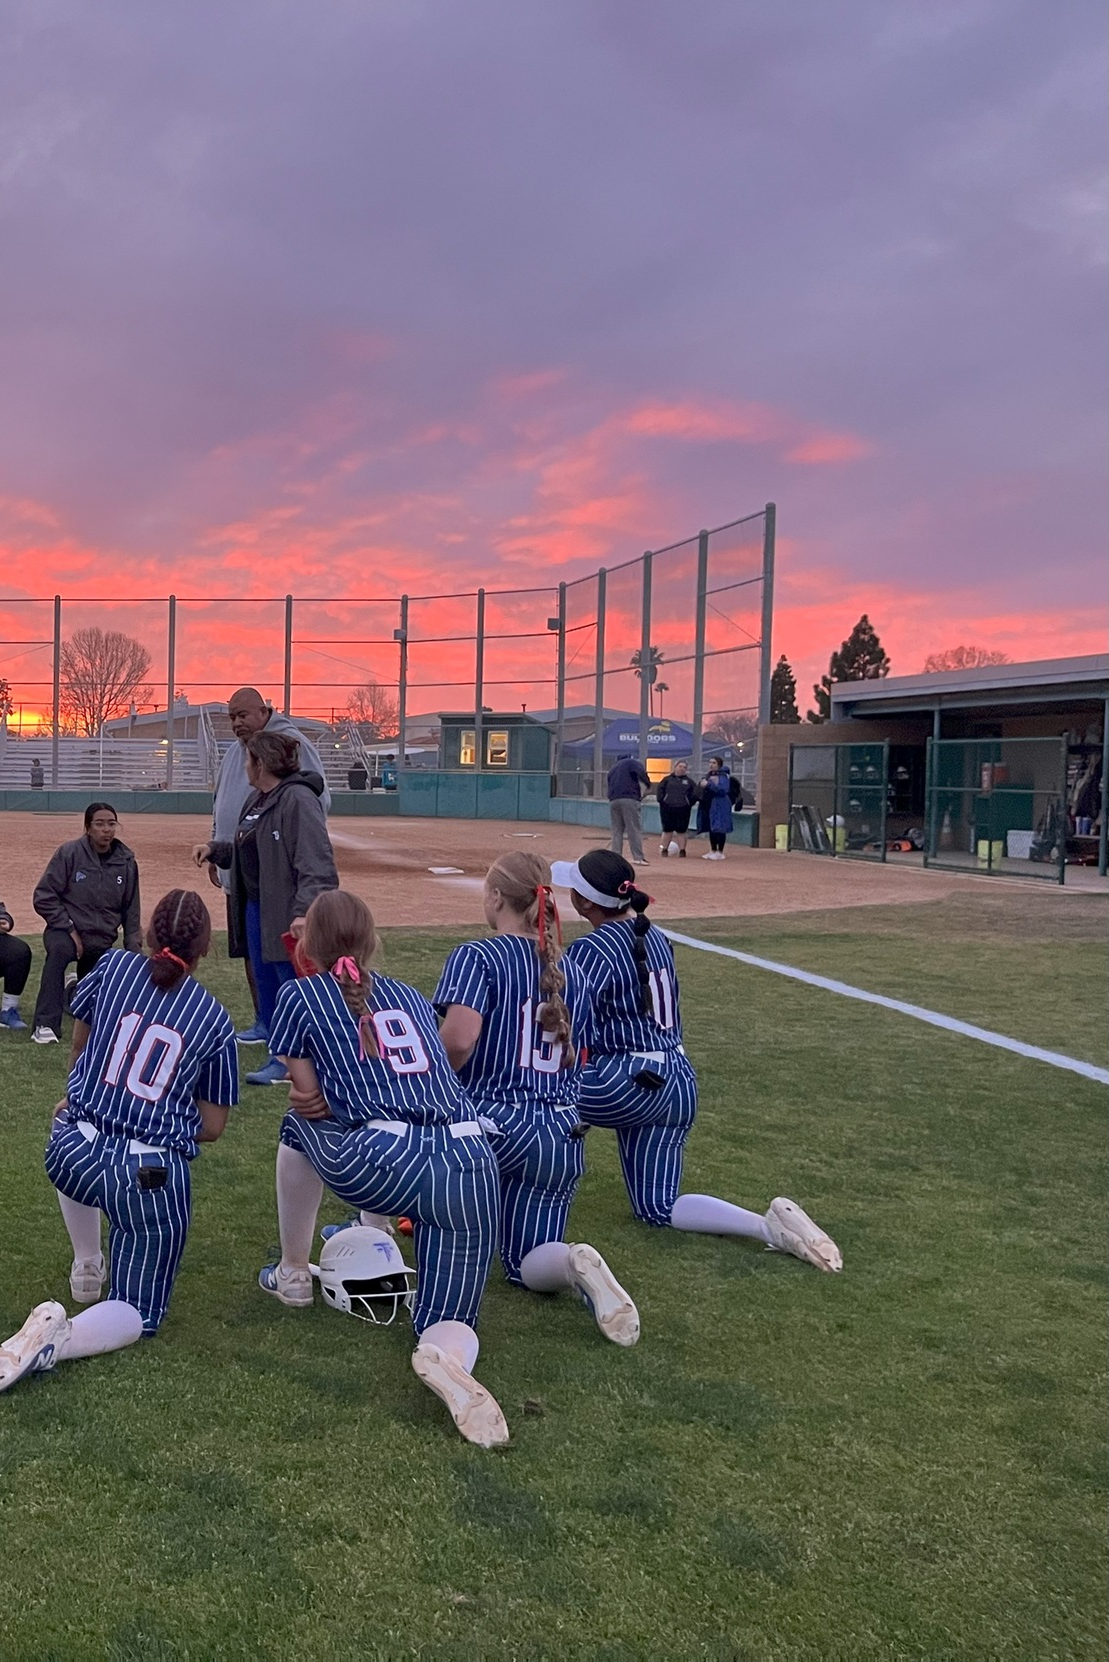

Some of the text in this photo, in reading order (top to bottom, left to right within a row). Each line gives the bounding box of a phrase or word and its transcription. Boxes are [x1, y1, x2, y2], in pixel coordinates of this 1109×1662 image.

[619, 734, 676, 742] BULDOGS
[104, 1011, 182, 1102] 10
[372, 1008, 429, 1074] 9
